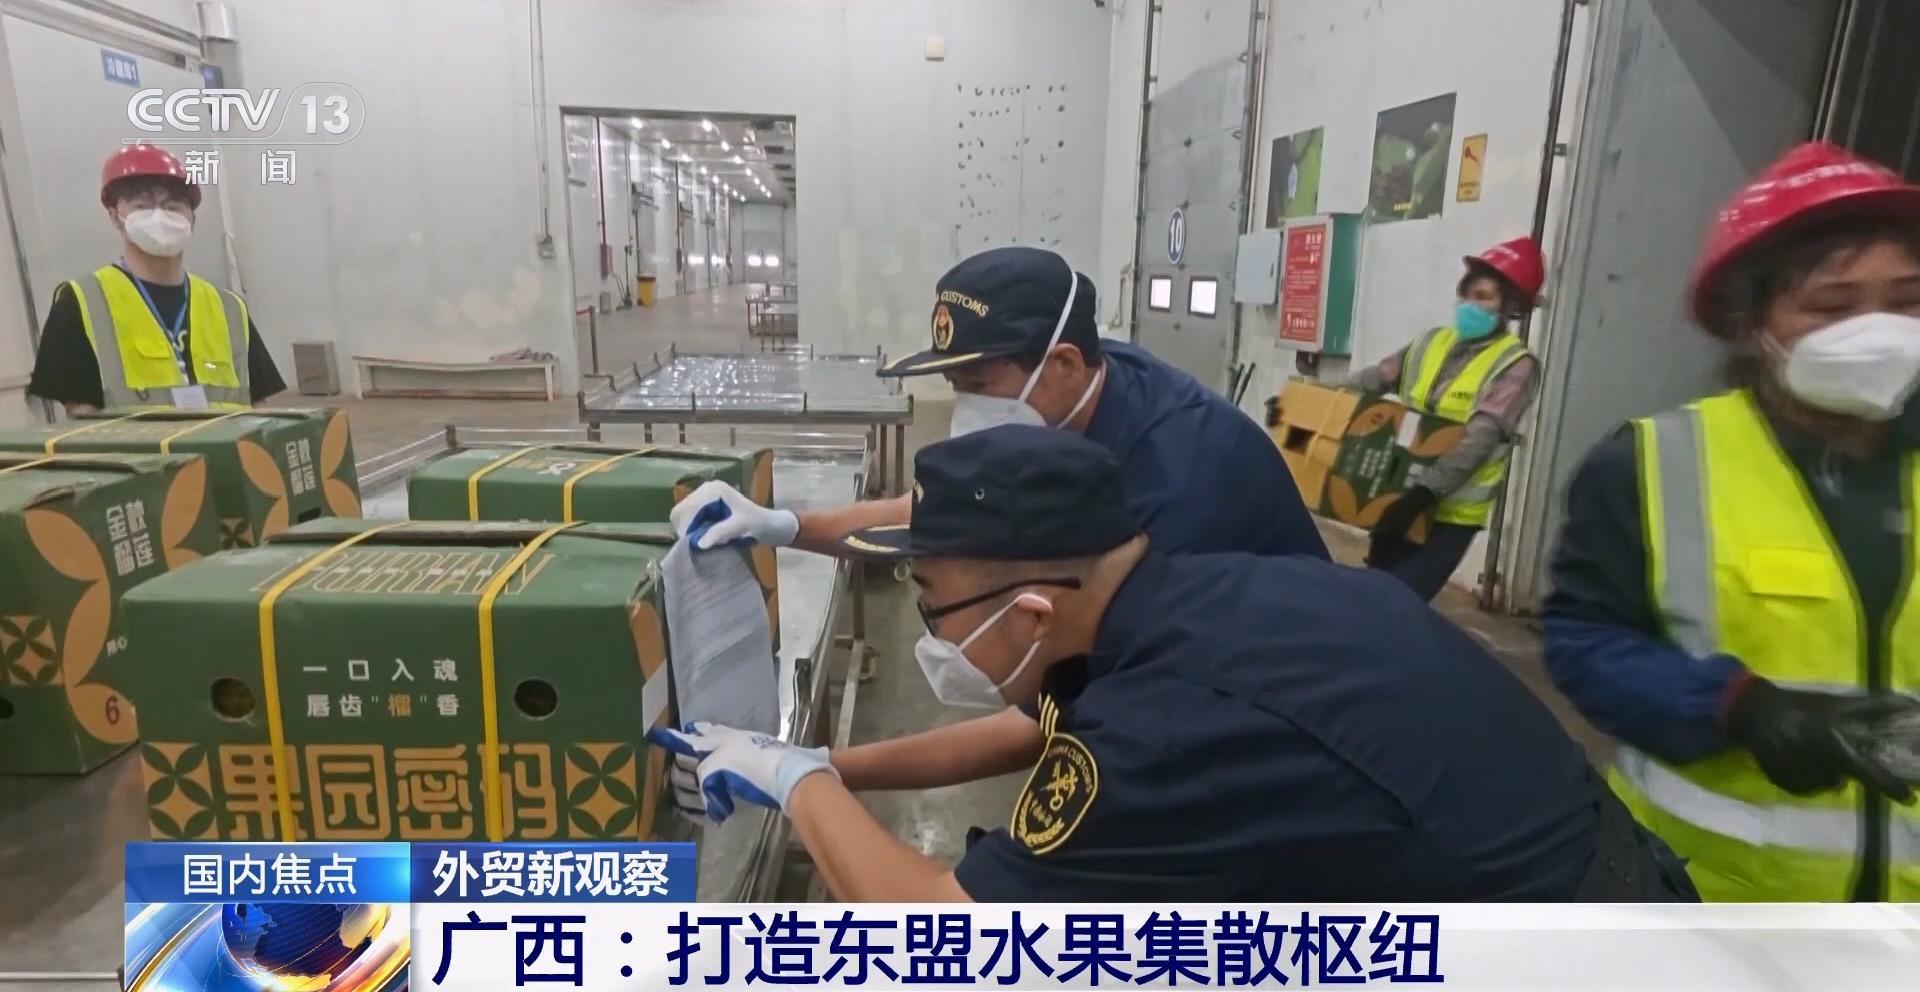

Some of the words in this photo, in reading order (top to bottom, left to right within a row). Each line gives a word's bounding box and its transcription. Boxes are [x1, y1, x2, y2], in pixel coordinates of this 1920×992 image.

[1170, 217, 1183, 254] 10
[940, 290, 989, 317] CUSTOMS
[303, 657, 459, 682] 一口入魂
[105, 695, 120, 726] 6
[218, 742, 559, 841] 果园密码
